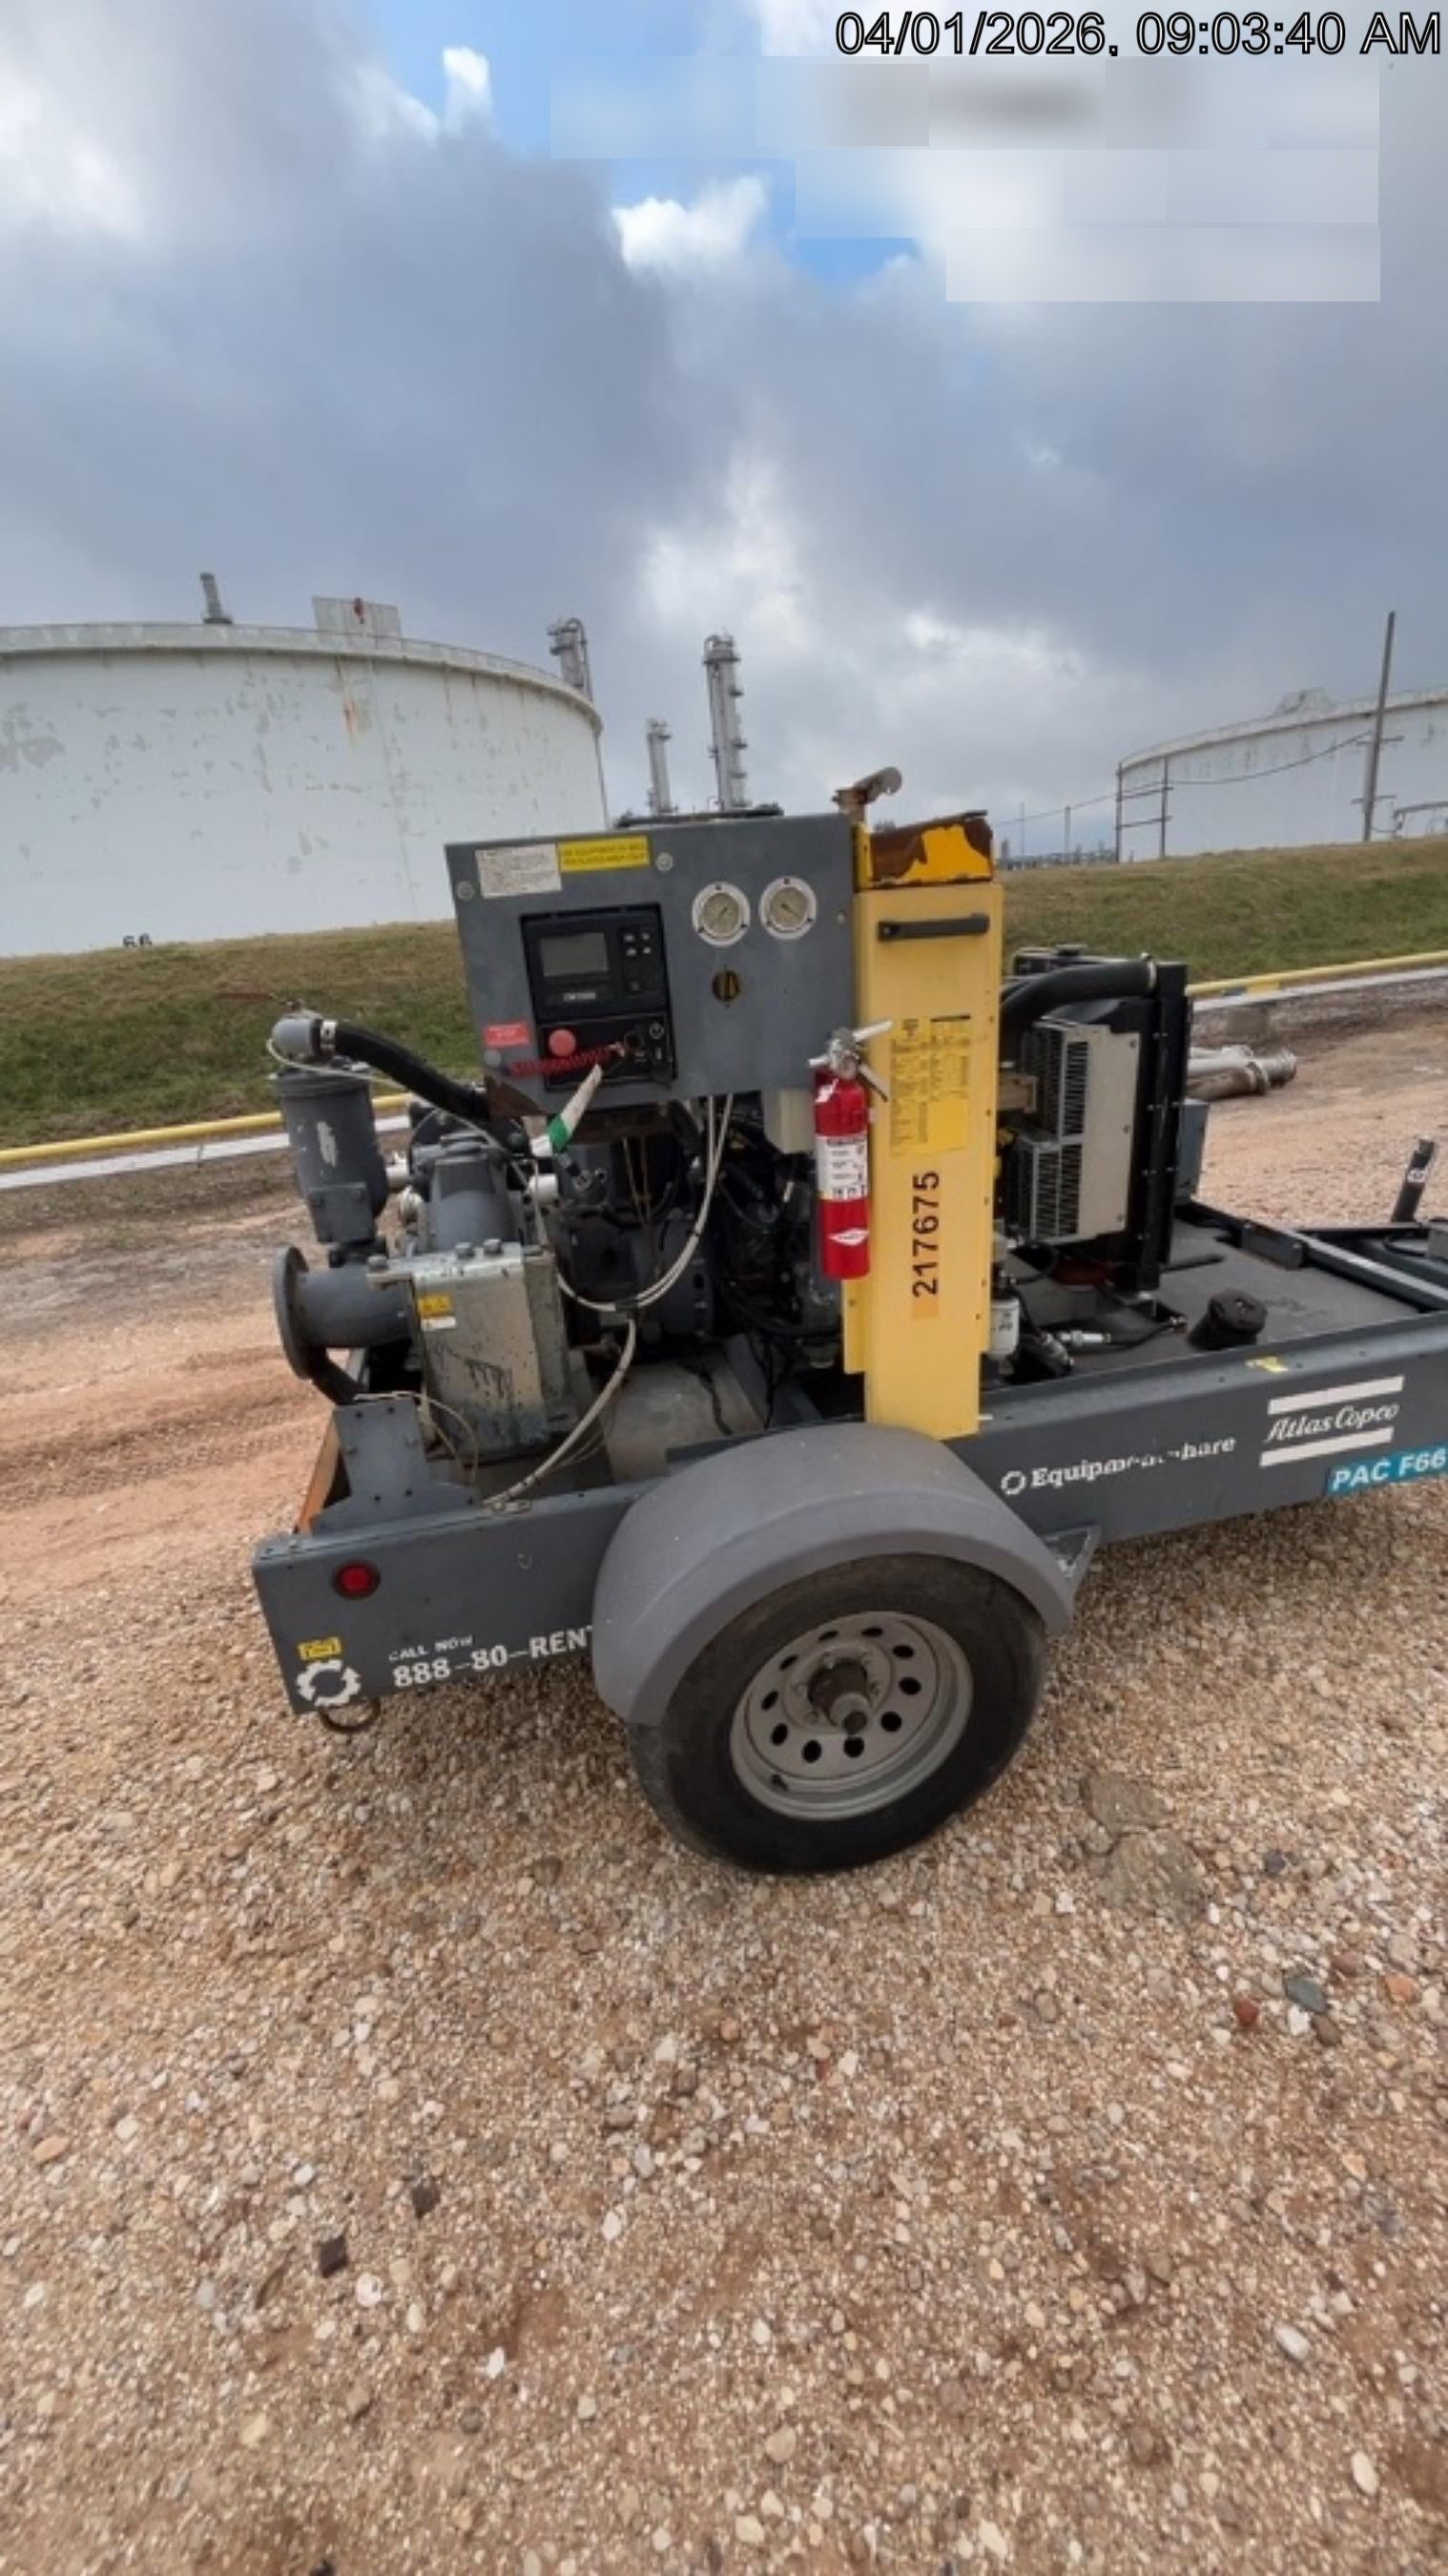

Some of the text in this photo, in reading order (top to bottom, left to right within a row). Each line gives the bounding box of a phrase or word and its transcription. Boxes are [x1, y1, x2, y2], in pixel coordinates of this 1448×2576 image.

[912, 1171, 940, 1297] 217675
[1263, 1402, 1400, 1443] Atlas Copco
[1333, 1447, 1447, 1492] PAC F66
[388, 1645, 428, 1661] CALL
